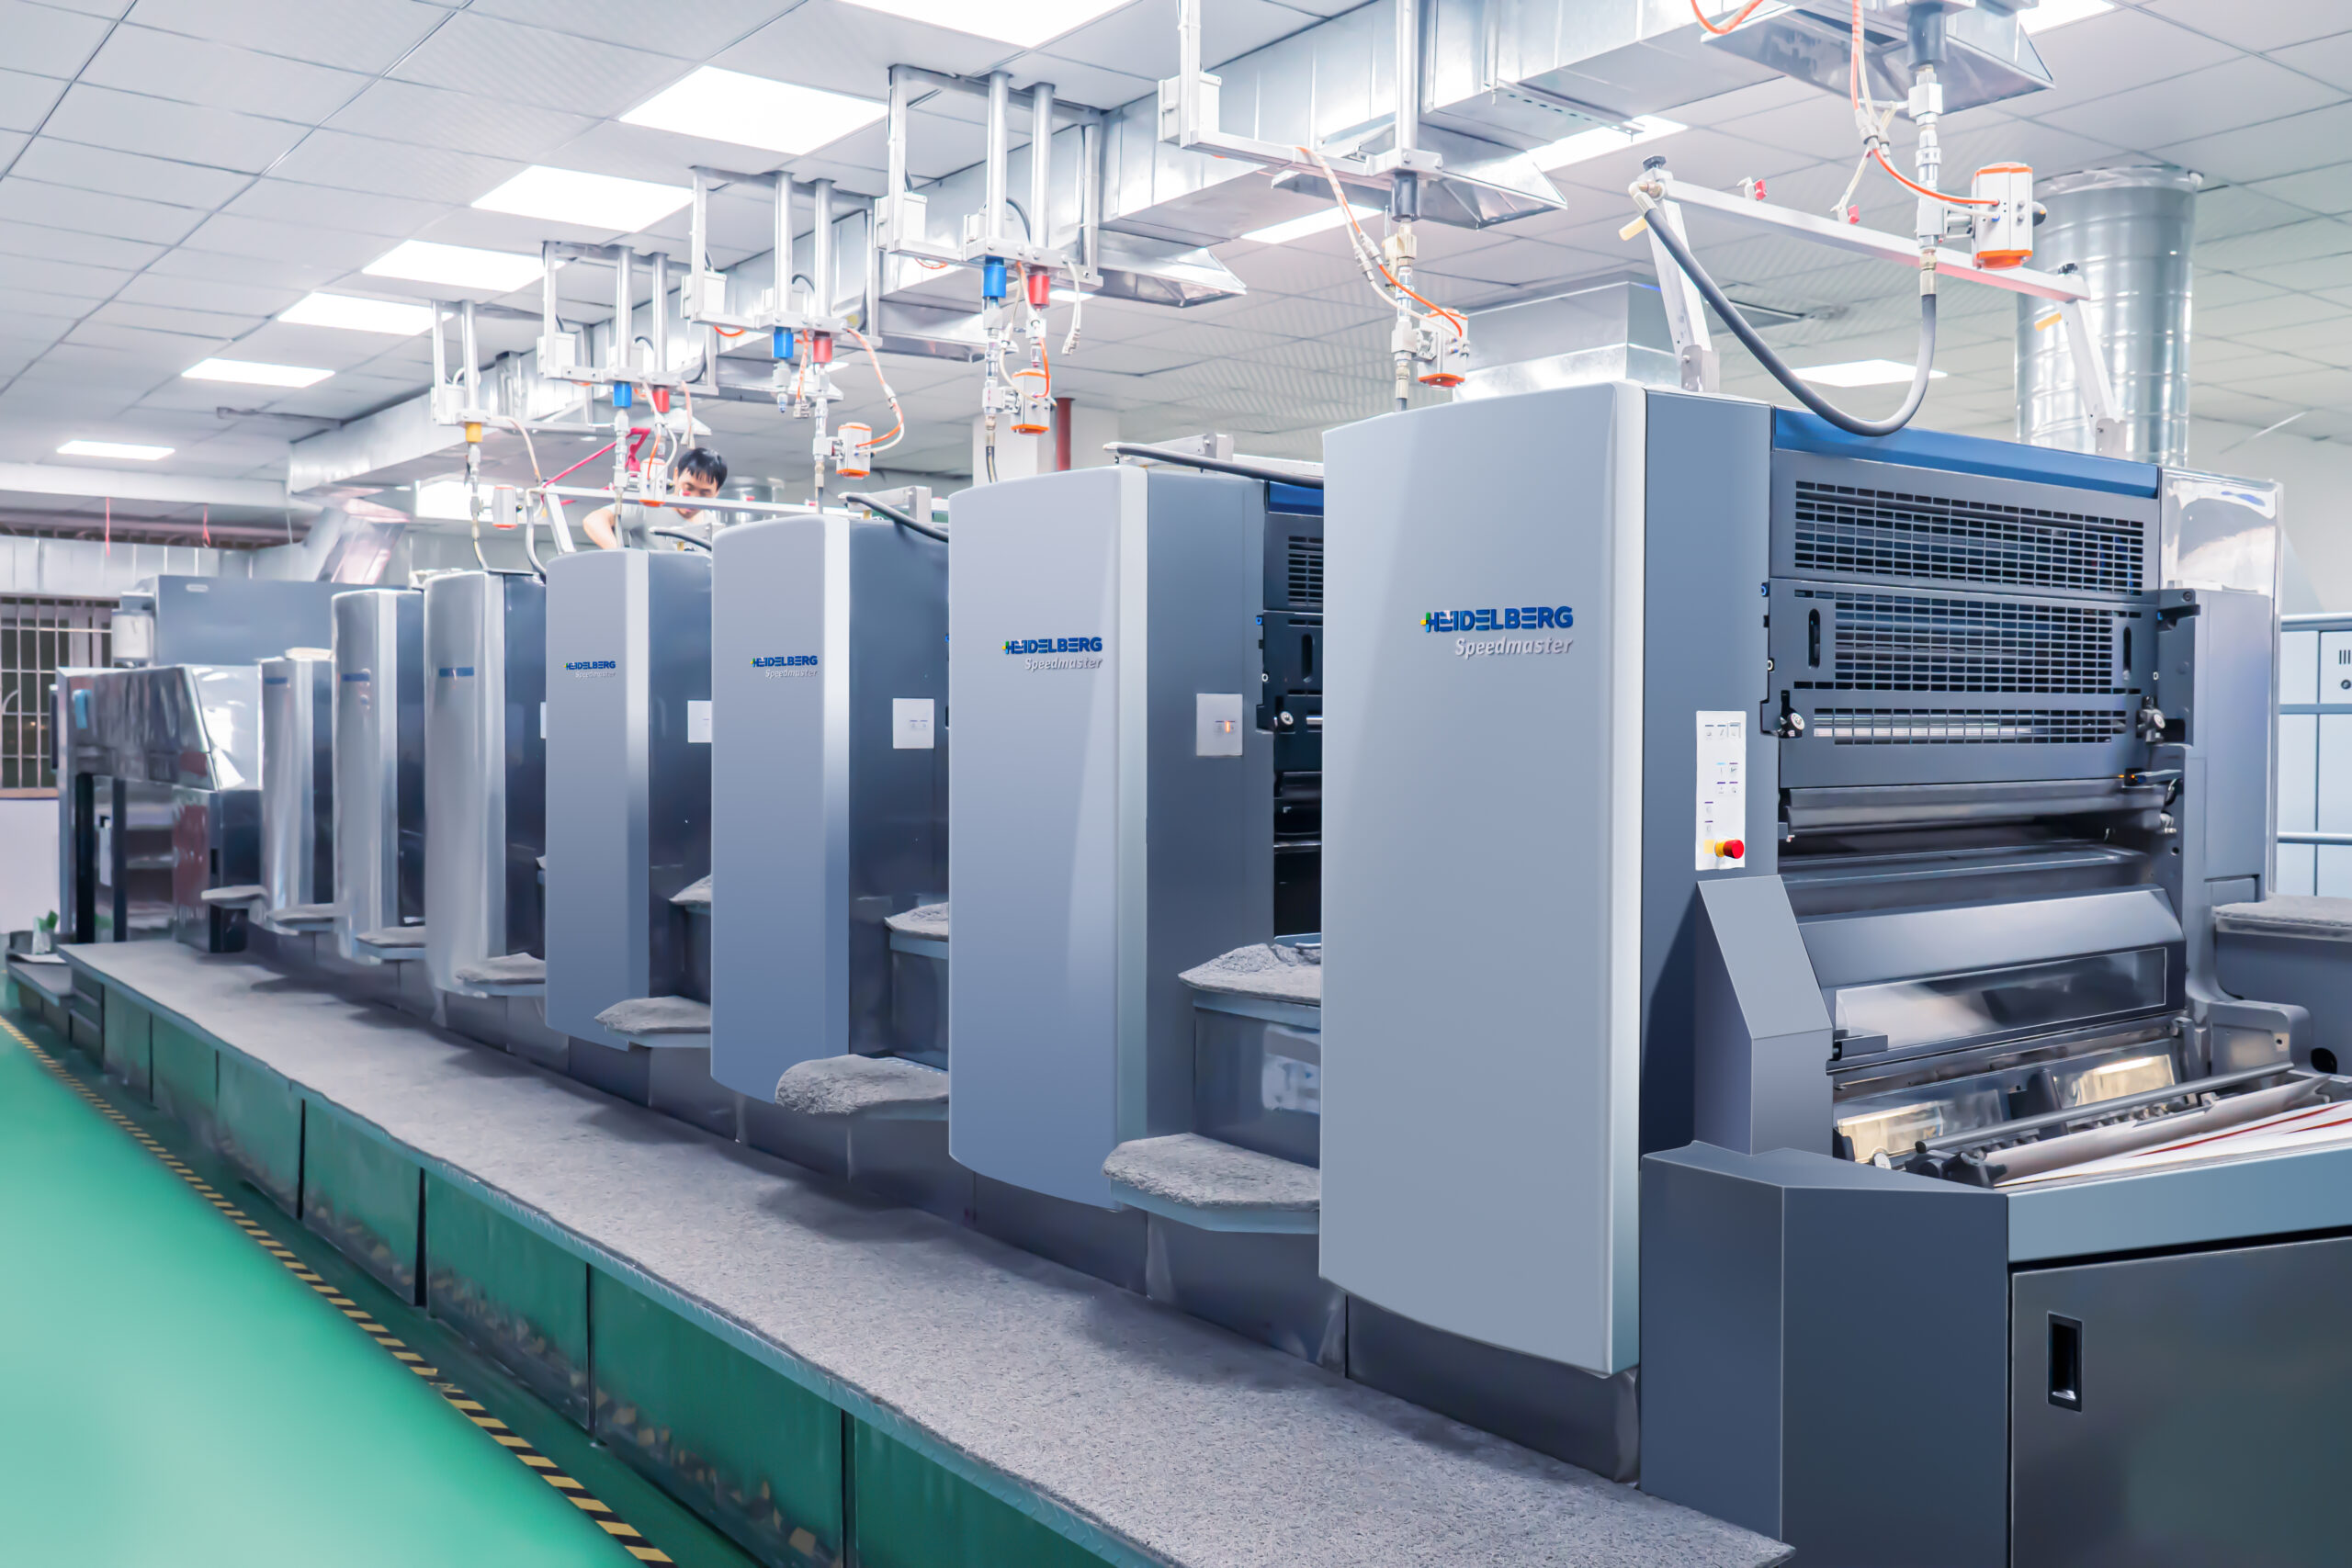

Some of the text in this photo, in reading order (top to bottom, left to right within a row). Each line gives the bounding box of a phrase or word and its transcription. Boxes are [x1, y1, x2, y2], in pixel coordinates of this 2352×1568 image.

[1420, 606, 1573, 632] HEIDELBERG
[1001, 637, 1102, 654] HEIDELBERG
[1455, 637, 1573, 659] Speedmaster
[563, 660, 616, 671] HEIDELBERG
[750, 655, 818, 667] HEIDELBERG
[1025, 658, 1102, 671] Speedmaster
